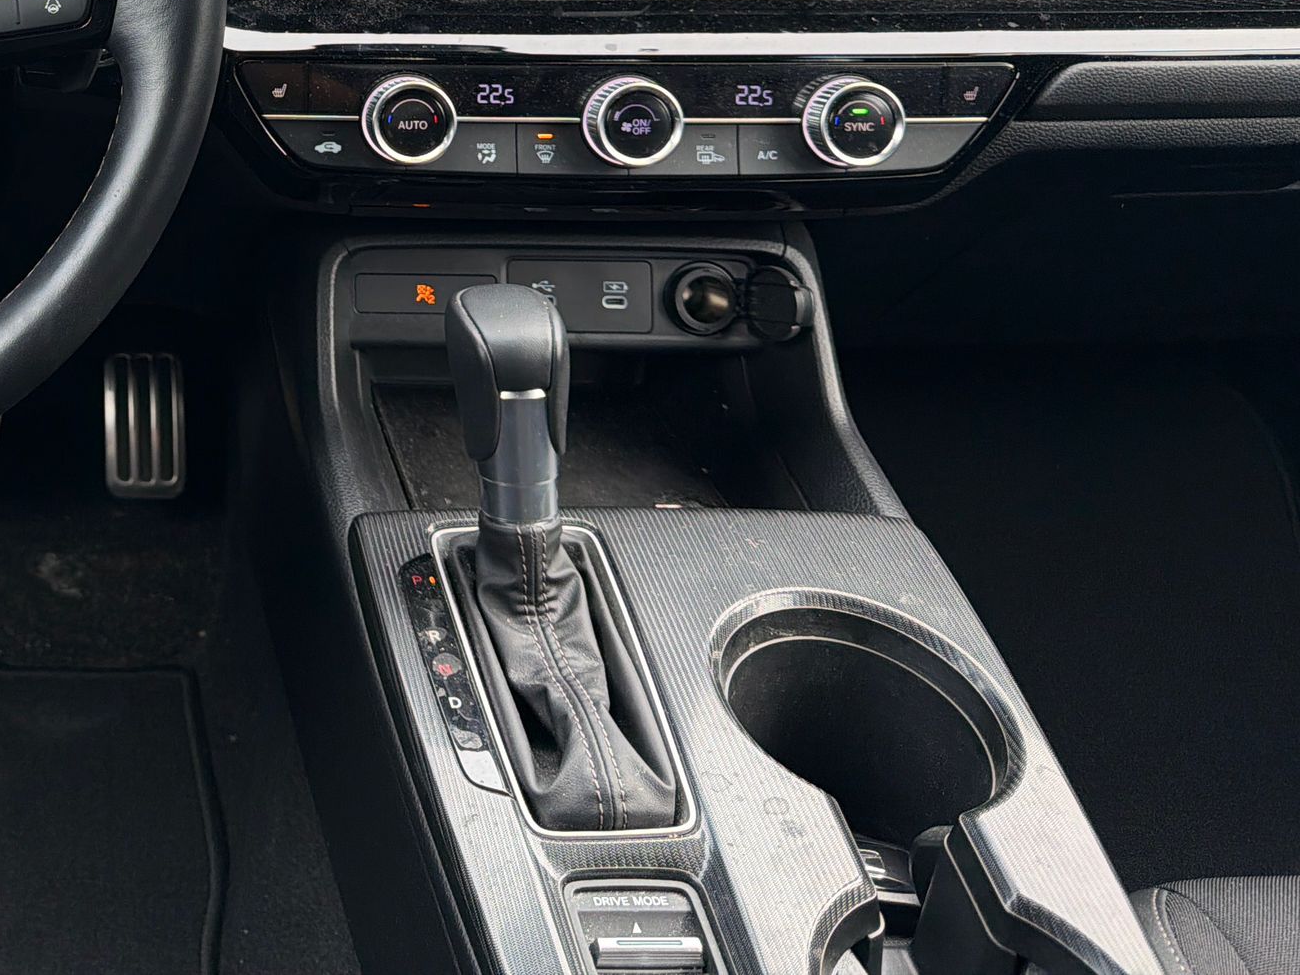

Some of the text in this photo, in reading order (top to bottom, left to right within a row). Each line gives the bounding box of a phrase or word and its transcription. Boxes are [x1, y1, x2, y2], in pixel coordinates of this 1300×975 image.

[398, 120, 428, 131] AUTO
[632, 118, 652, 127] ON/
[844, 121, 875, 132] SYNC
[632, 127, 652, 136] OFF
[476, 142, 496, 151] MODE
[534, 143, 556, 152] FRONT
[696, 144, 714, 152] REAR
[757, 150, 778, 161] A/C
[412, 575, 422, 587] P
[428, 629, 442, 644] R
[437, 663, 454, 677] N
[448, 696, 462, 709] D
[593, 896, 669, 907] DRIVE MODE
